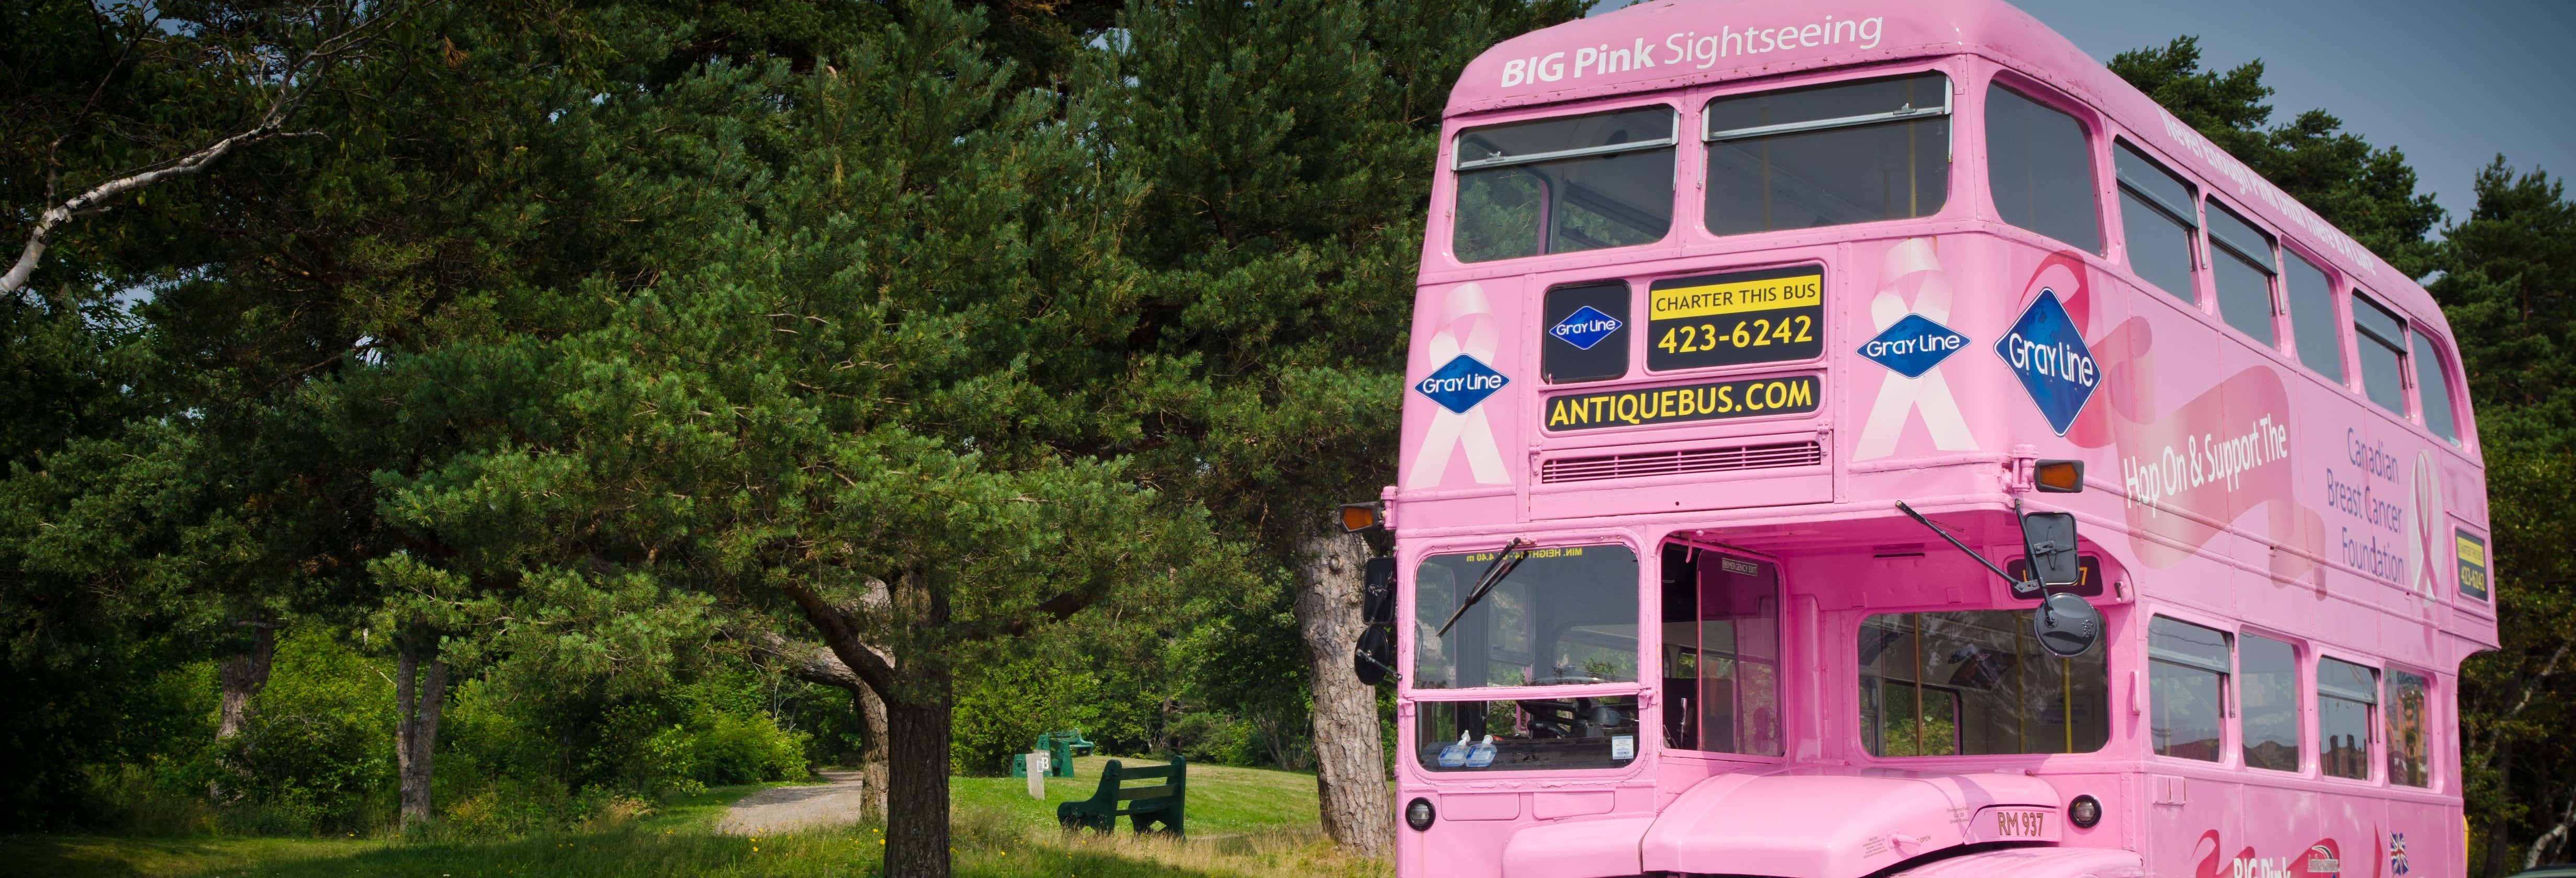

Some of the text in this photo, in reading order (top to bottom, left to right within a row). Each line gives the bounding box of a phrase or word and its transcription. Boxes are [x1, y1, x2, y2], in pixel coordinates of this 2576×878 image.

[1501, 15, 1883, 88] BIG Pink Sightseeing
[2157, 106, 2203, 159] Never
[2198, 134, 2251, 194] Enough
[2244, 167, 2279, 210] Pink
[1655, 283, 1816, 313] CHARTER THIS BUS
[1556, 320, 1616, 335] Gray Line
[1658, 315, 1813, 354] 423-6242
[1867, 334, 1960, 357] Gray Line
[1422, 373, 1502, 394] Gray Line
[2009, 333, 2093, 387] Gray Line
[1549, 379, 1812, 426] ANTIQUEBUS.COM
[2124, 413, 2287, 518] Hop On & Support The
[2347, 427, 2399, 485] Canadian
[2327, 468, 2402, 535] Breast Cancer
[2342, 526, 2405, 585] Foundation
[1919, 835, 1931, 843] OPEN
[1997, 812, 2044, 836] RM 937
